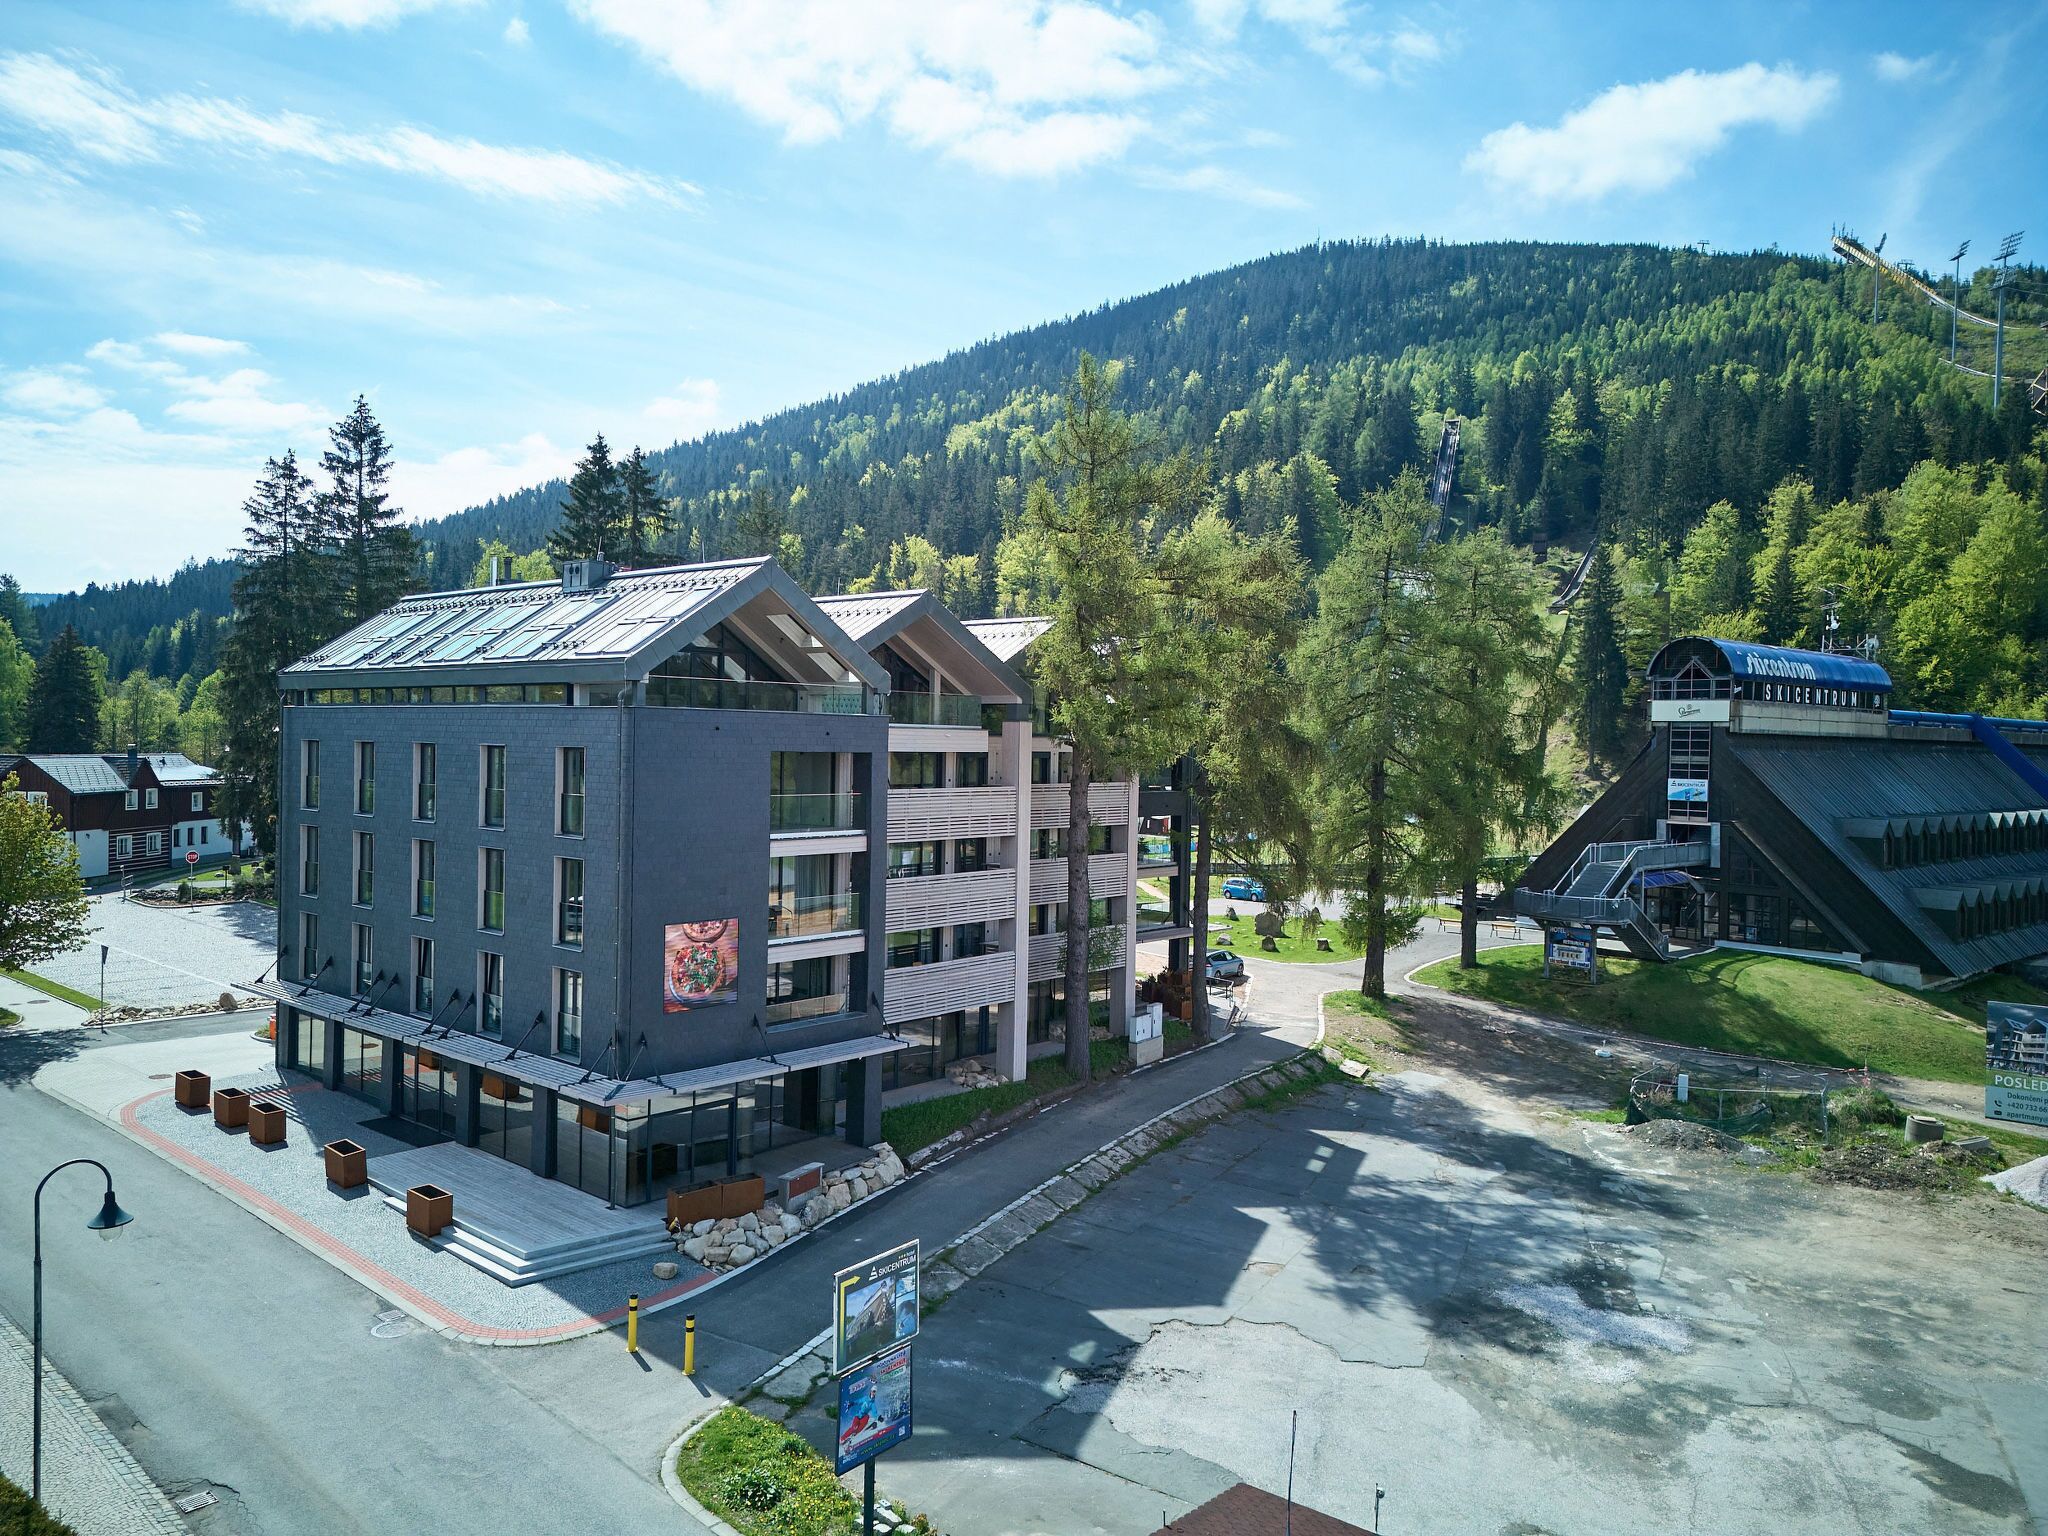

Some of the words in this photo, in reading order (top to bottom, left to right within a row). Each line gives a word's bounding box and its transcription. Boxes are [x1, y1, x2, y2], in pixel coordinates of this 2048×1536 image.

[1765, 684, 1857, 707] SKICENTRUM
[2007, 1102, 2024, 1110] +420
[2025, 1103, 2038, 1112] 732
[878, 1254, 917, 1277] SKICENTRUM
